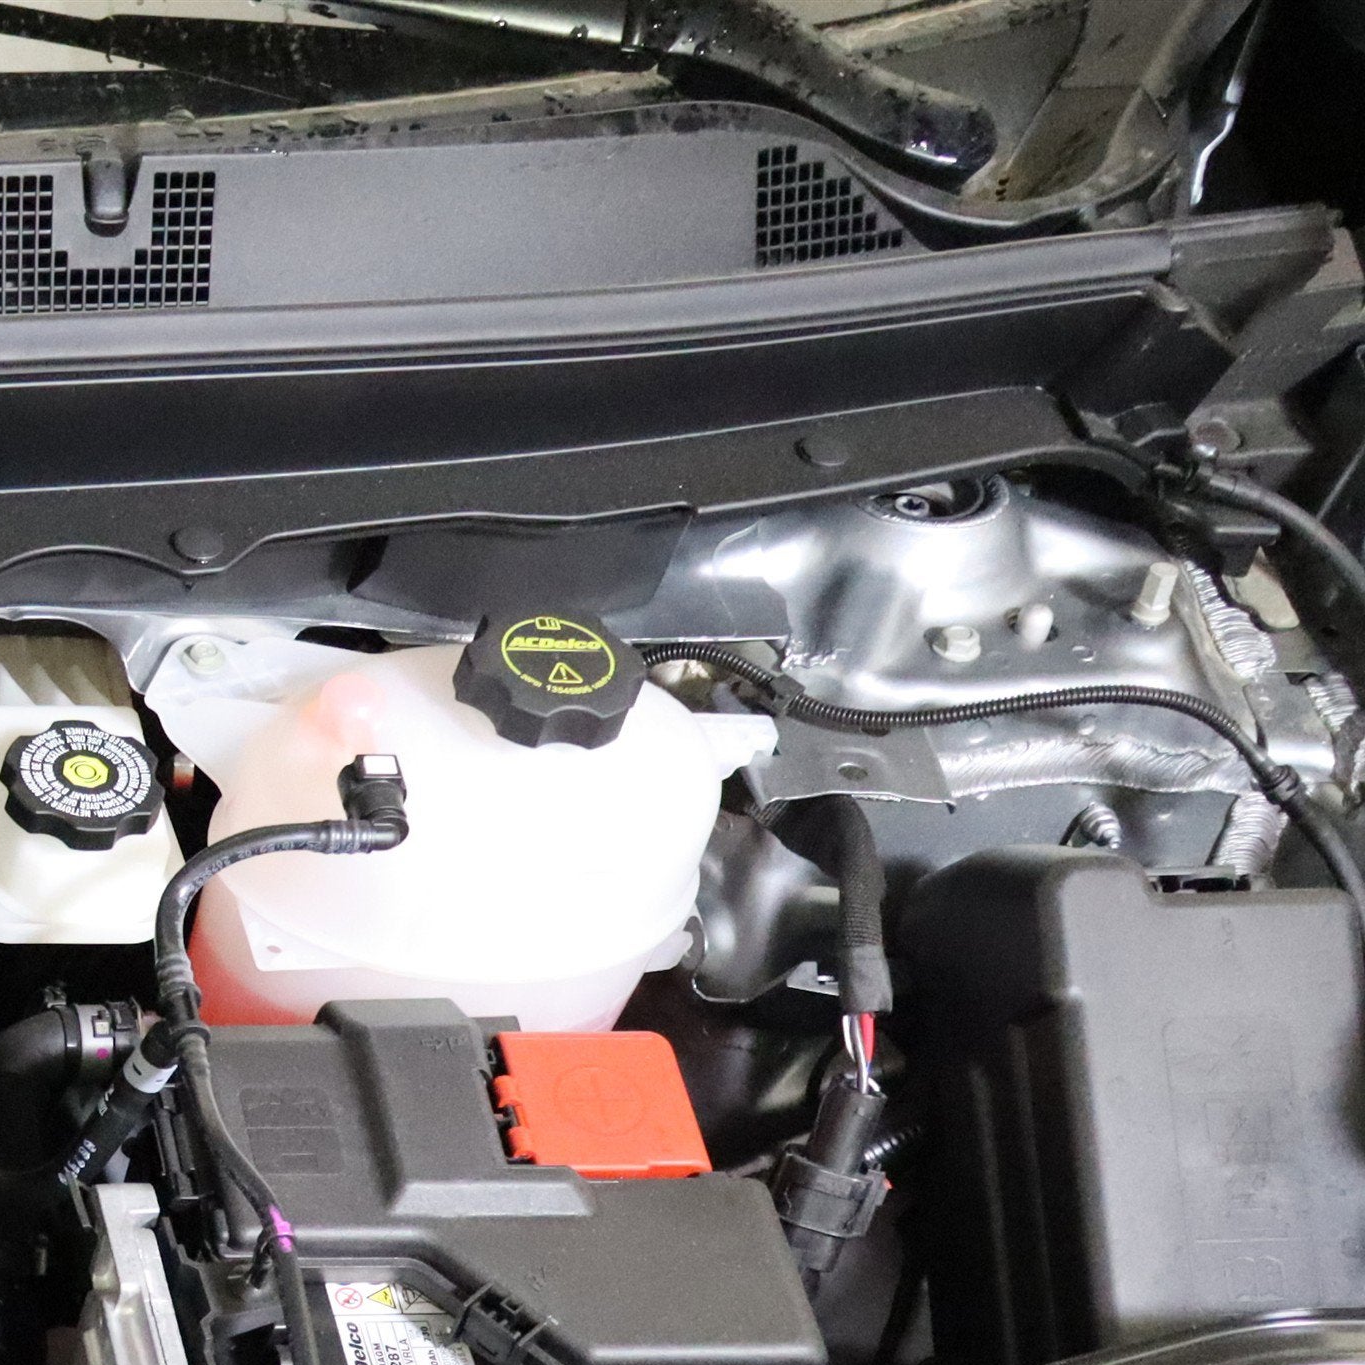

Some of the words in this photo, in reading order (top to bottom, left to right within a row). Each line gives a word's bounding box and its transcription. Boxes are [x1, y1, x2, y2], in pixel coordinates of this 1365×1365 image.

[507, 636, 602, 652] ACDelco
[69, 743, 99, 752] FILLER
[398, 1338, 414, 1363] VRLA
